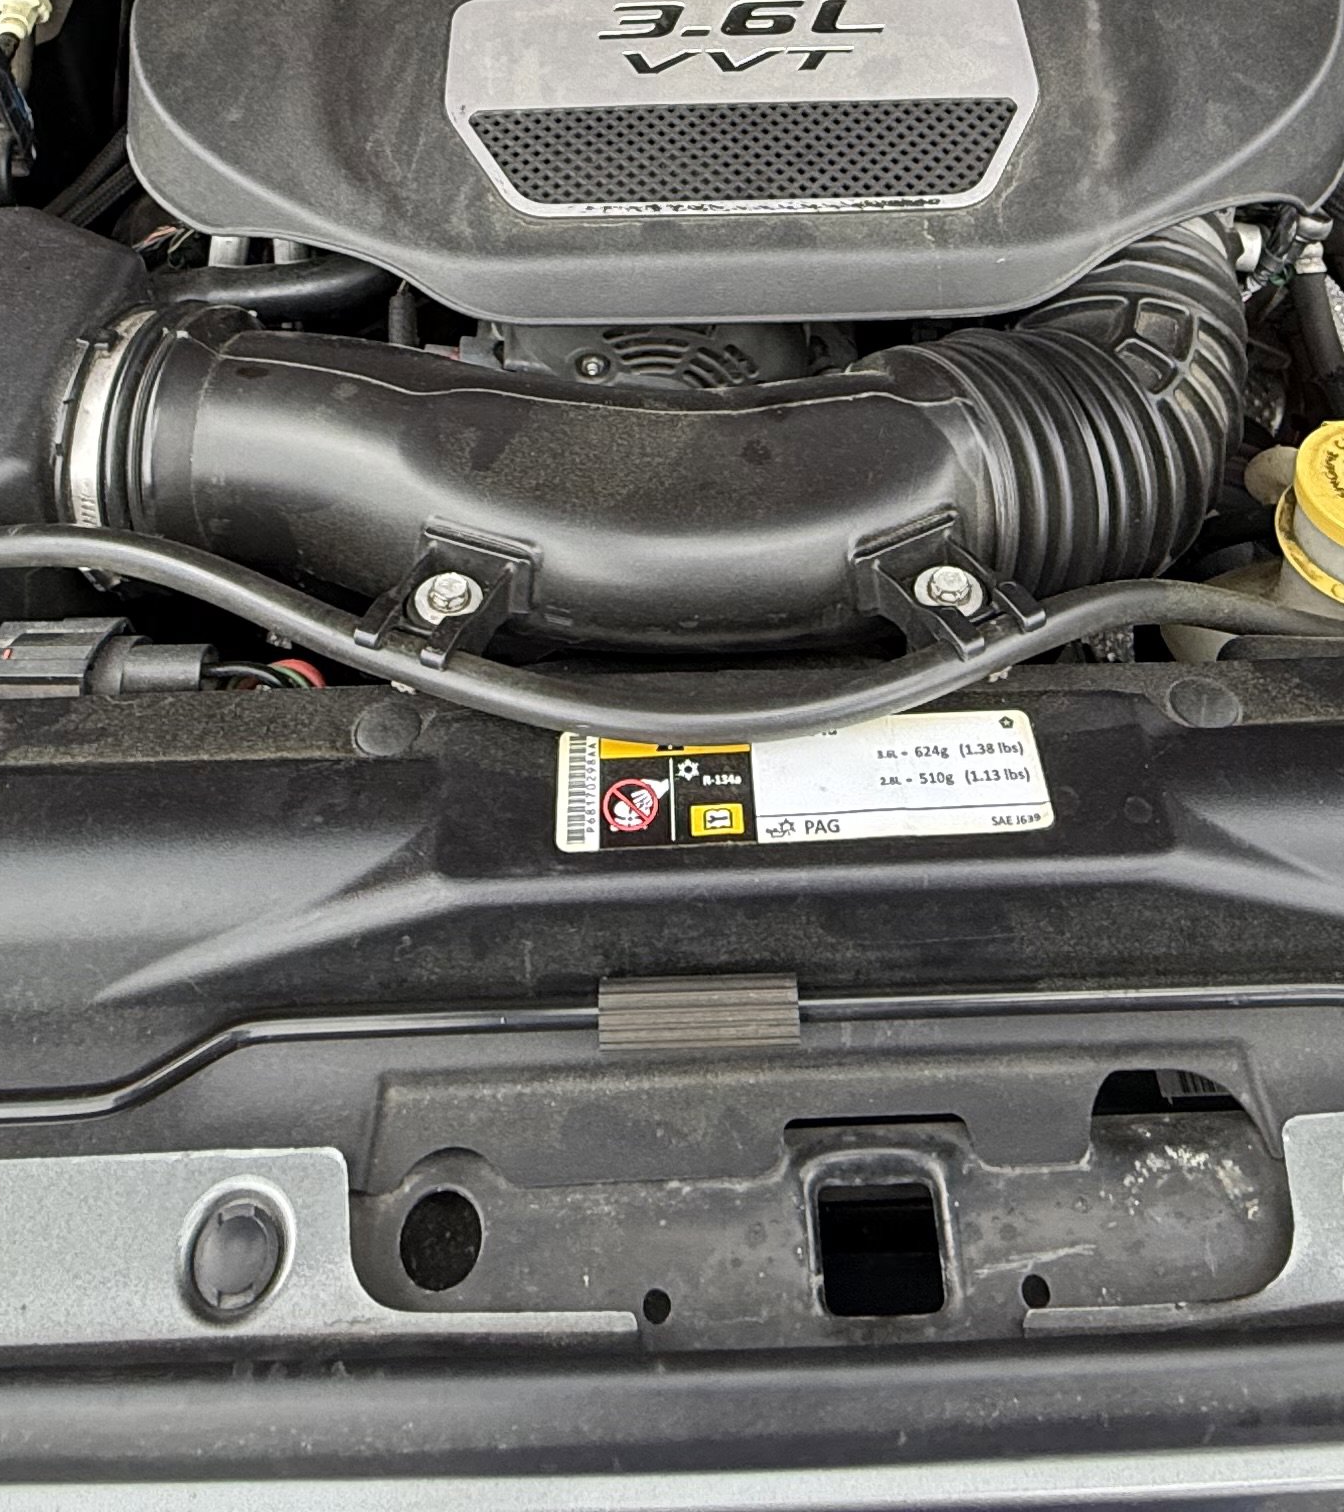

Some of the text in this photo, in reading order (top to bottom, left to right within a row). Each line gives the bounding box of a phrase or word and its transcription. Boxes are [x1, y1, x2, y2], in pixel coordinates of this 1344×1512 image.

[622, 45, 855, 75] VVT
[914, 745, 950, 759] 624g
[958, 742, 995, 759] (1.38
[997, 741, 1025, 756] lbs)
[918, 771, 955, 787] 510g
[964, 768, 1001, 786] (1.13
[1003, 766, 1031, 783] lbs)
[804, 818, 841, 835] PAG
[991, 814, 1013, 827] SAE
